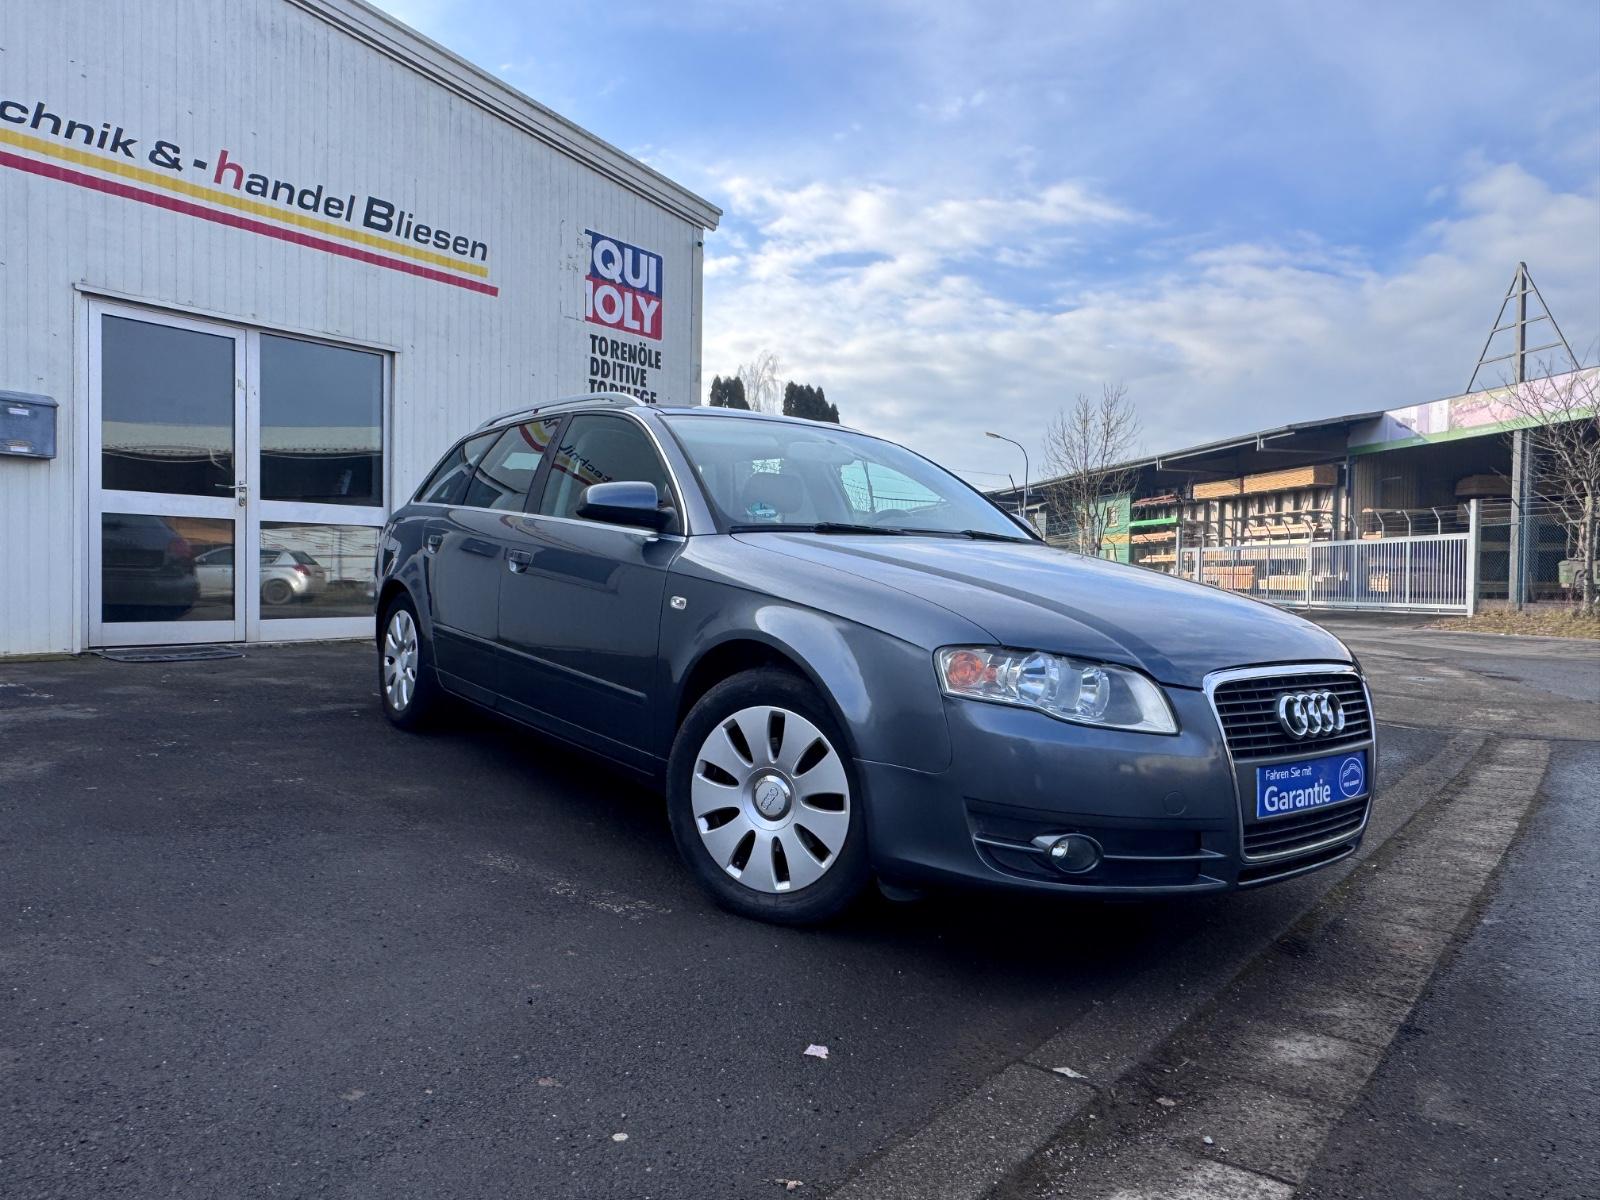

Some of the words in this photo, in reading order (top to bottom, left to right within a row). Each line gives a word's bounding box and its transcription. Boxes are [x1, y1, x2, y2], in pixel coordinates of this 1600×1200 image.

[148, 141, 183, 172] &
[363, 196, 488, 261] Bliesen
[1266, 768, 1289, 781] Fahren
[1290, 766, 1301, 778] Sie
[1265, 779, 1331, 812] Garantie
